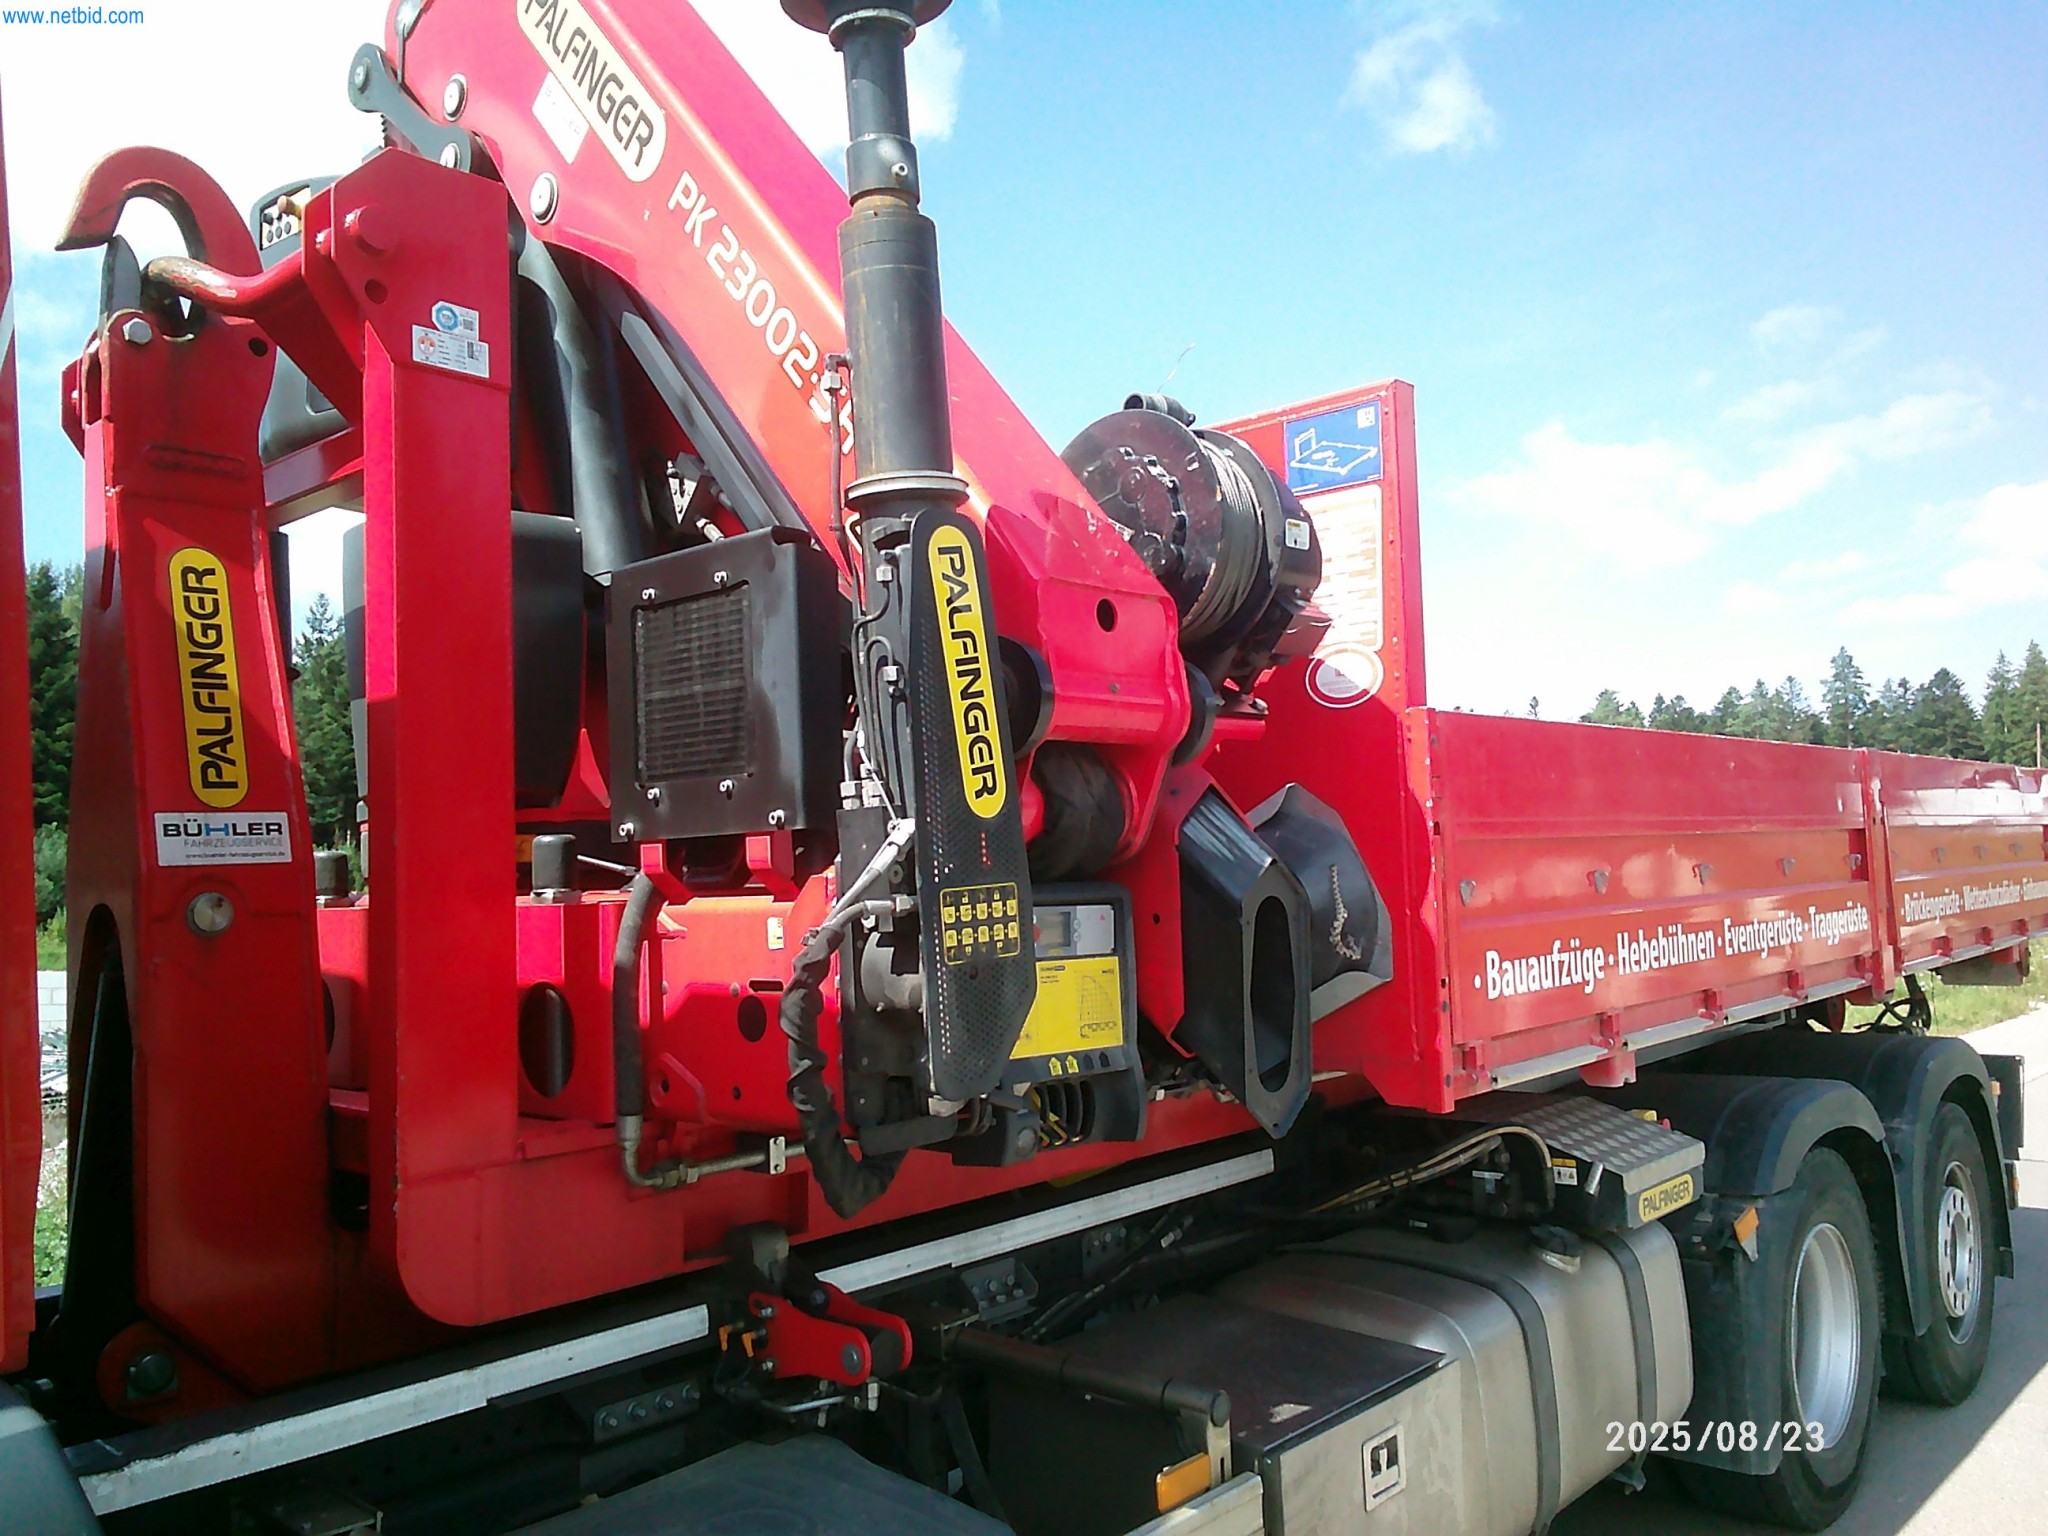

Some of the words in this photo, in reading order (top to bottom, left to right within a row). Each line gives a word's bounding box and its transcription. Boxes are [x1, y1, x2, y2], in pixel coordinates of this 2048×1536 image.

[667, 171, 718, 248] PK
[180, 566, 239, 790] PALFINGER
[937, 543, 998, 801] PALFINGER
[162, 818, 283, 837] BÜHLER
[1485, 937, 1606, 1000] Bauaufzüge
[1616, 922, 1716, 976] Hebebühnen
[1723, 910, 1804, 960] Eventgerüste
[1808, 900, 1869, 946] Traggerüste
[1642, 1180, 1691, 1217] PALFINGER
